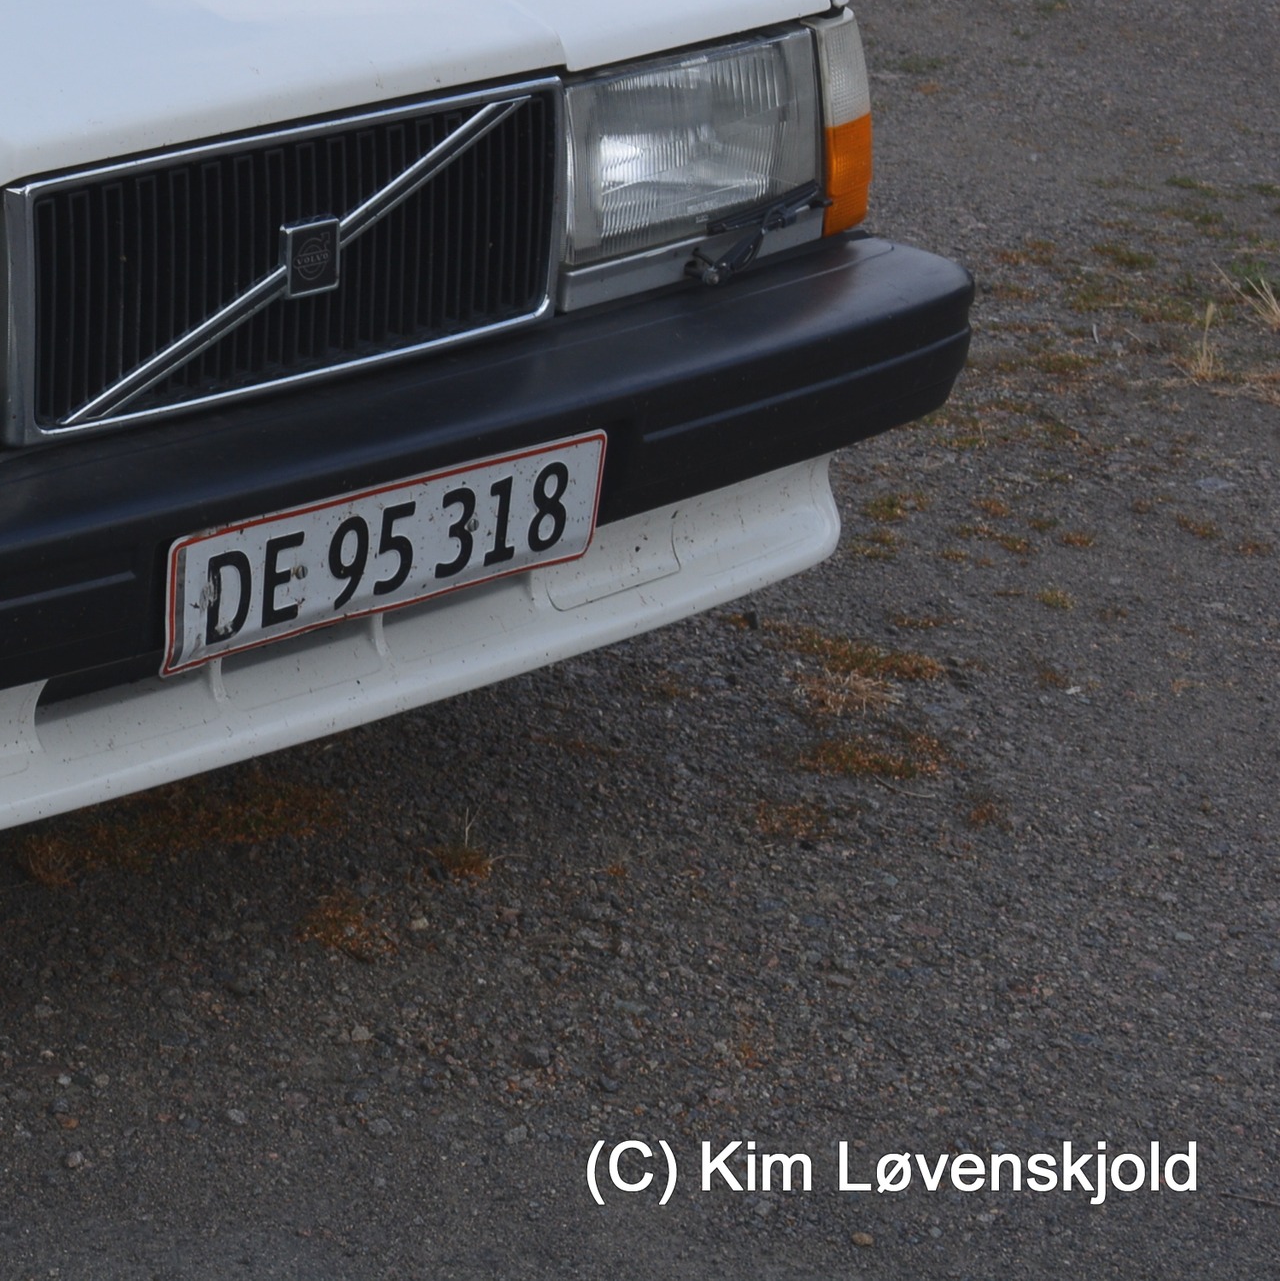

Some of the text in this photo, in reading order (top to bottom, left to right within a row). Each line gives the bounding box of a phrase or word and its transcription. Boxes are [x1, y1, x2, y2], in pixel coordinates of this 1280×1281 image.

[297, 253, 329, 265] VOLVO
[205, 461, 570, 646] DE 95 318
